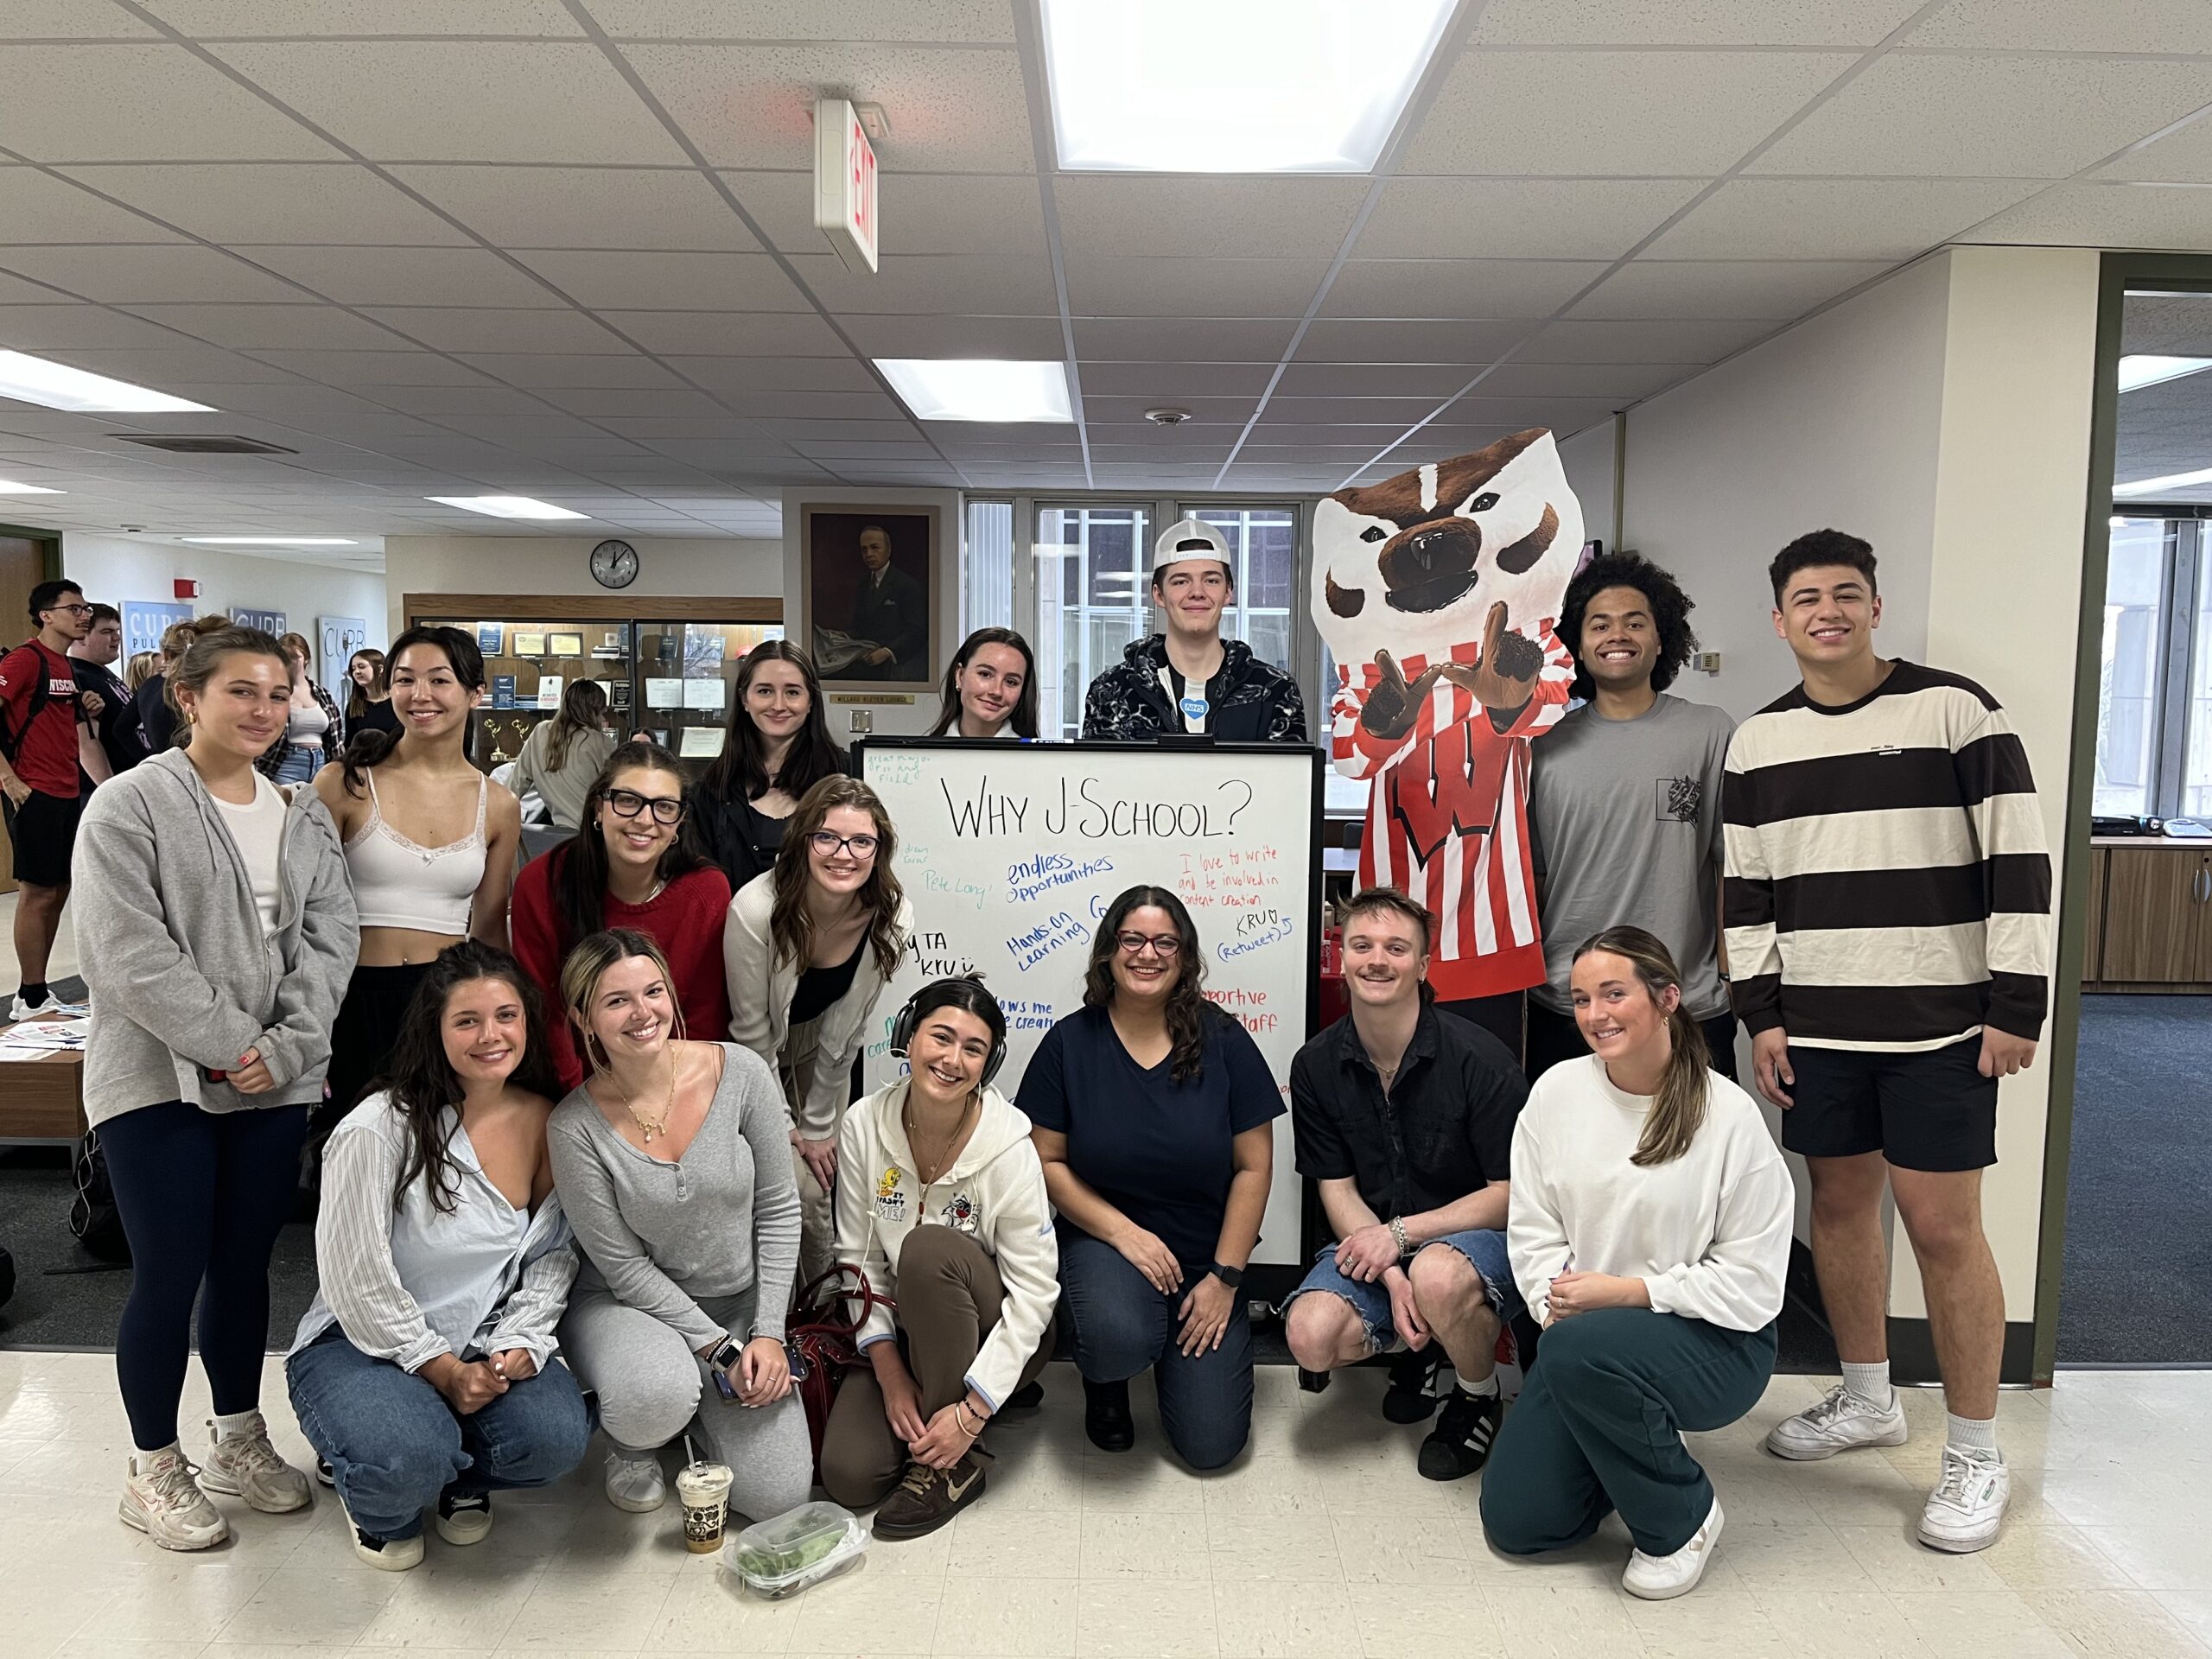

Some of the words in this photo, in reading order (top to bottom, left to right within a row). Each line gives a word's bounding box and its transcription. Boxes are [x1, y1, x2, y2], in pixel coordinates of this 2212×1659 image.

[940, 775, 1029, 838] WHY
[1006, 852, 1073, 886] endless
[1178, 854, 1192, 874] I
[1200, 854, 1224, 872] love
[1229, 848, 1241, 866] to
[1245, 845, 1278, 862] write
[920, 869, 953, 893] Pete
[1006, 855, 1114, 904] opportunities
[1178, 875, 1196, 892] and
[1205, 874, 1217, 890] be
[1223, 870, 1264, 887] involved
[1266, 873, 1279, 886] in
[1221, 893, 1262, 907] creation
[1236, 912, 1267, 938] KRU
[905, 934, 921, 963] y
[921, 931, 947, 950] TA
[1032, 1002, 1052, 1015] me
[1202, 988, 1268, 1007] portive
[1015, 1016, 1055, 1030] creati
[874, 1204, 906, 1223] ME!
